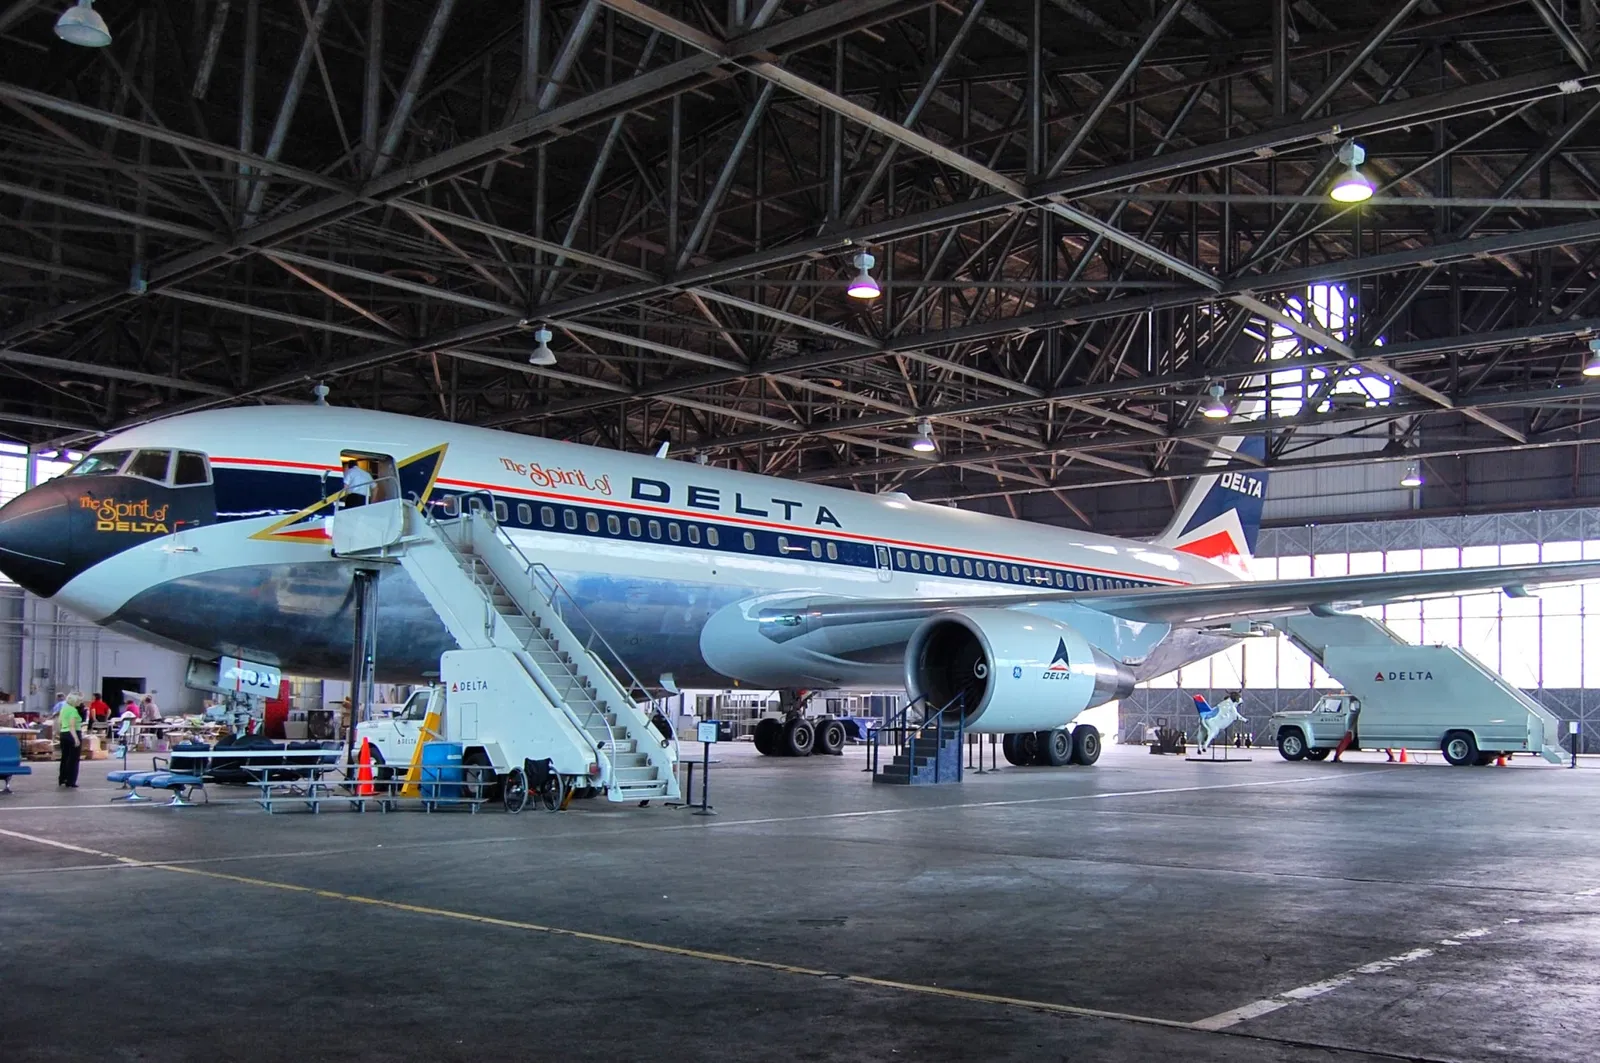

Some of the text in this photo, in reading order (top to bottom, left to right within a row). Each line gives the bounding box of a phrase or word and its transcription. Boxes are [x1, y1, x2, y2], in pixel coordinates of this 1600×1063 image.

[1220, 472, 1262, 498] DELTA
[499, 457, 842, 528] The Spirit of DELTA
[80, 496, 169, 521] The Spirit of
[97, 521, 169, 533] DELTA
[1042, 671, 1070, 680] DELTA
[1388, 671, 1433, 681] DELTA
[460, 681, 488, 691] DELTA
